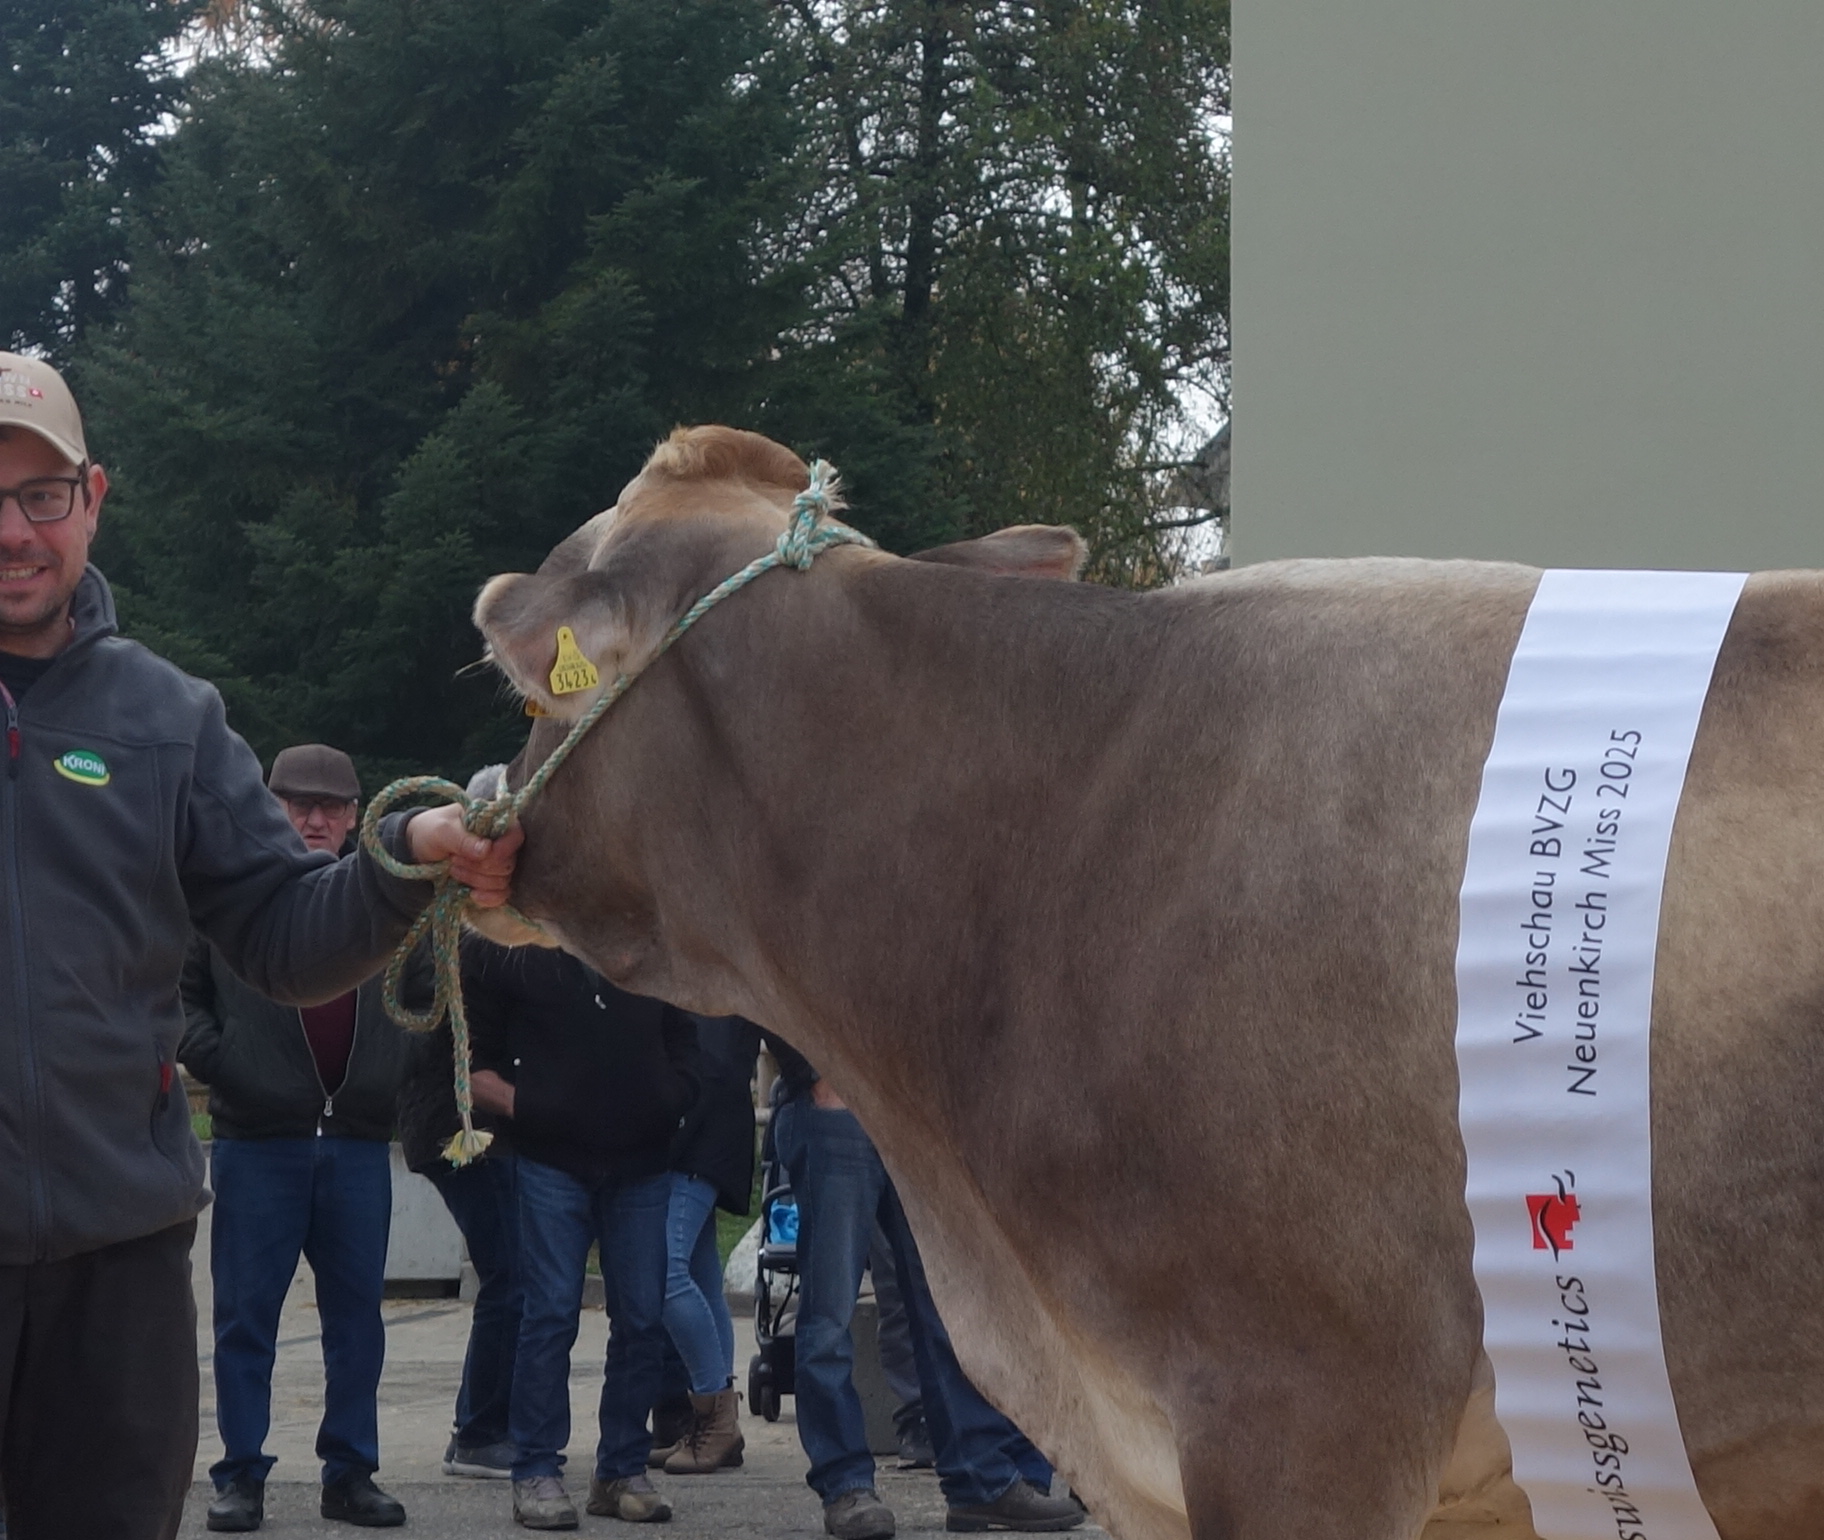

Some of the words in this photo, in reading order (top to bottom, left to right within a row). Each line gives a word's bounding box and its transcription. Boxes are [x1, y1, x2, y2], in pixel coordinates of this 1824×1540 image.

[63, 754, 106, 777] KRONI
[1597, 729, 1642, 799] 2025
[1530, 766, 1576, 859] BVZG
[1580, 808, 1621, 878] Miss
[1513, 872, 1556, 1044] Viehschau
[1567, 892, 1608, 1096] Neuenkirch
